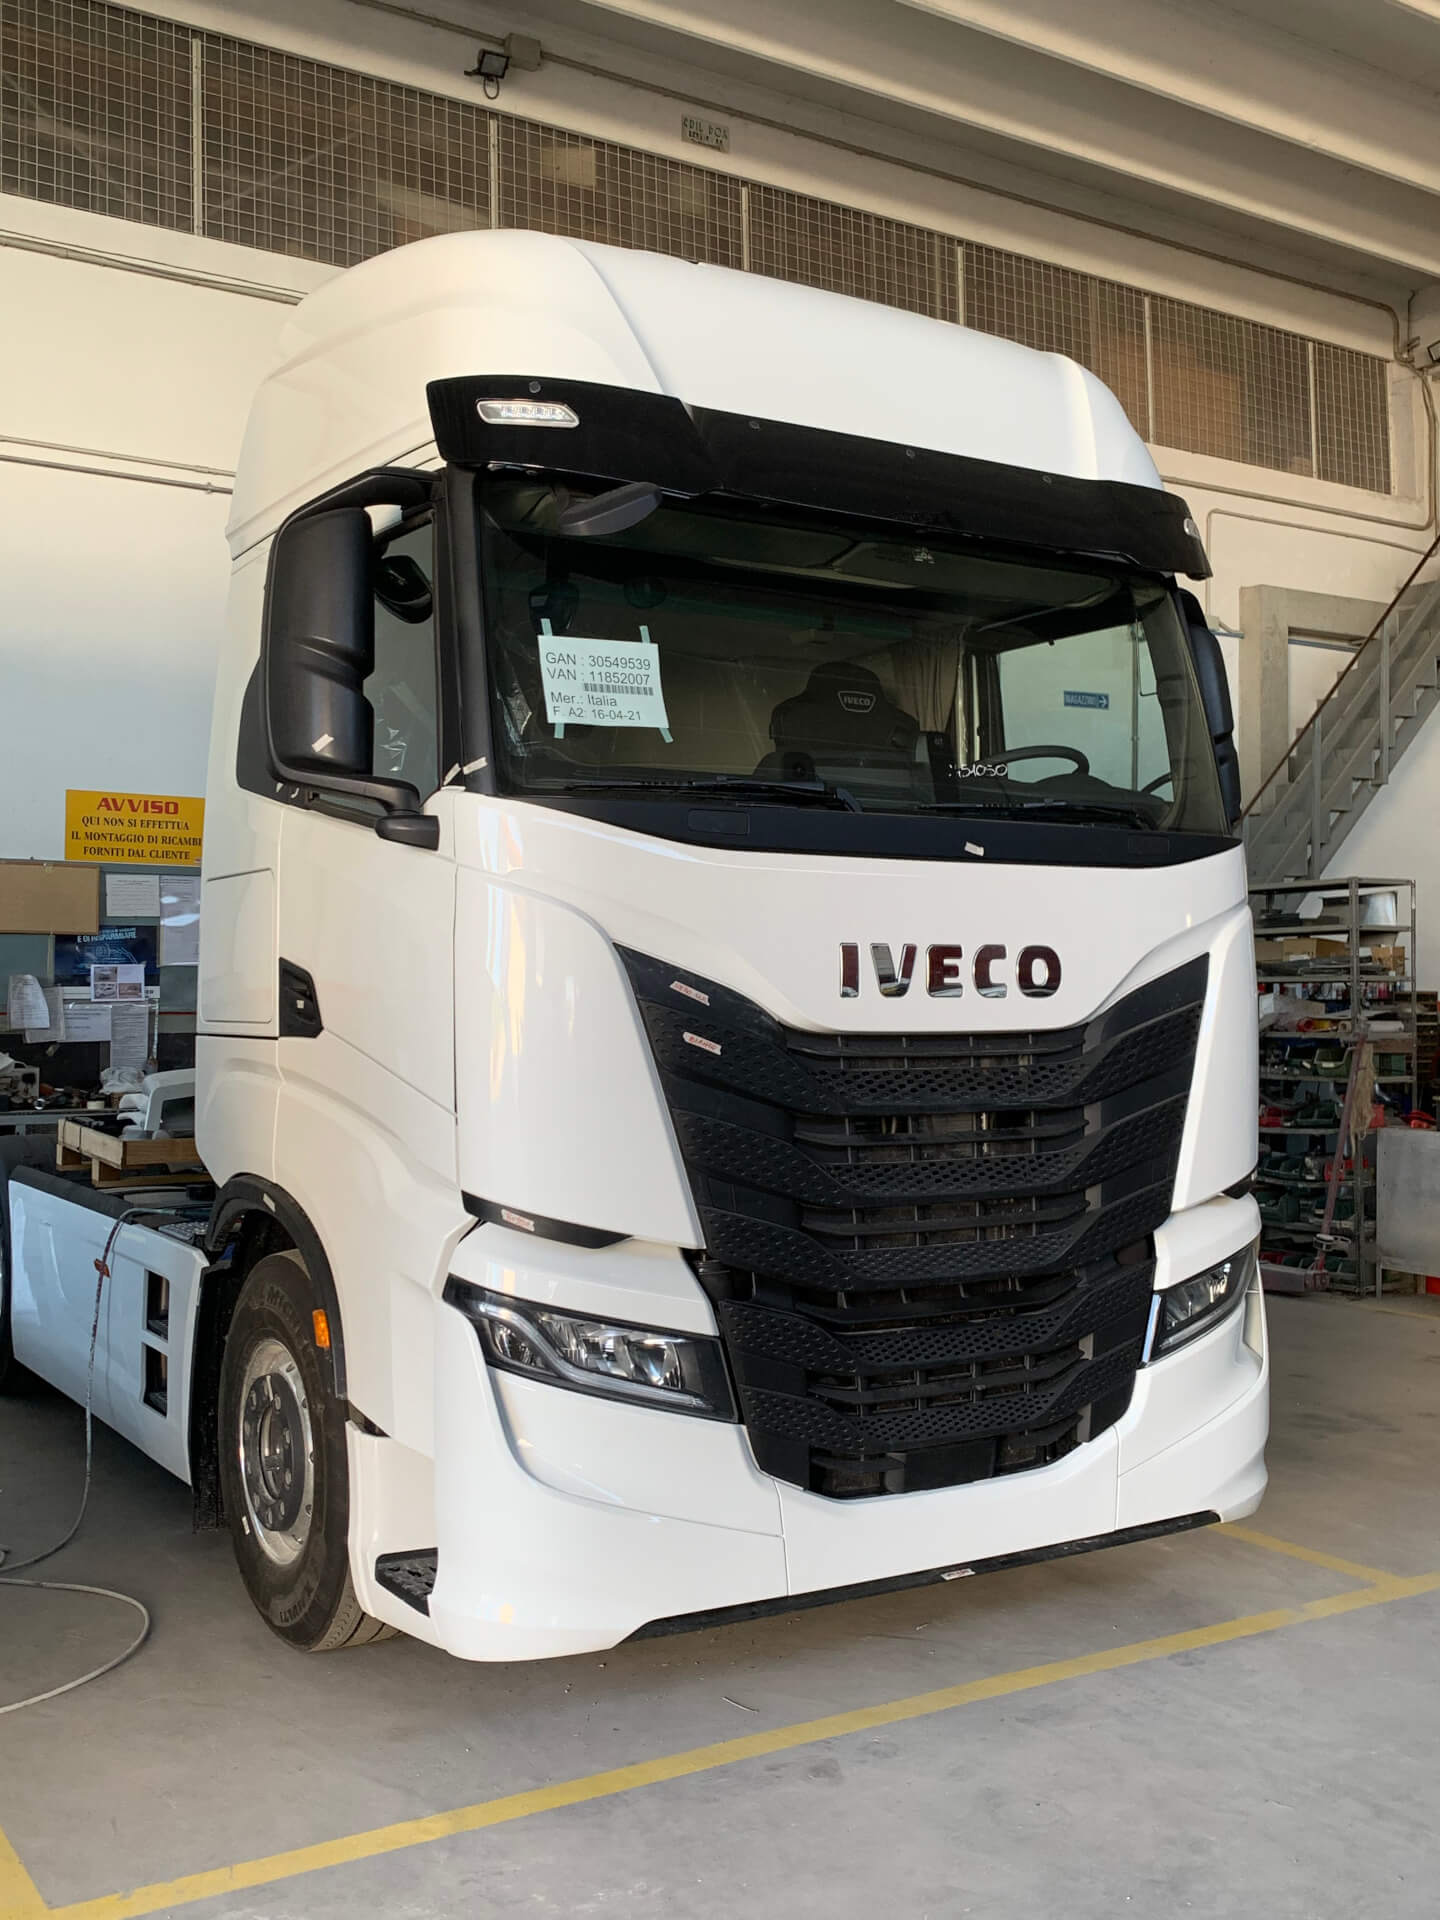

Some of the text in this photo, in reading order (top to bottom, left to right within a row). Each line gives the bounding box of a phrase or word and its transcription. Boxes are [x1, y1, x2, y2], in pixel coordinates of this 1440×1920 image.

[545, 651, 576, 665] GAN
[588, 655, 651, 671] 30549539
[547, 667, 577, 681] VAN
[589, 671, 650, 685] 11852007
[587, 694, 617, 707] Italia
[843, 695, 871, 706] IVECO
[592, 709, 641, 721] 16-04-21
[97, 797, 179, 815] AVVISO
[81, 815, 190, 831] QUI NON SI EFFETTUA
[71, 830, 81, 841] IL
[84, 831, 145, 844] MONTAGGIO
[147, 835, 158, 844] DI
[83, 846, 125, 857] FORNITI
[128, 848, 147, 858] DAL
[149, 849, 191, 860] CLIENTE
[839, 942, 1063, 998] IVECO
